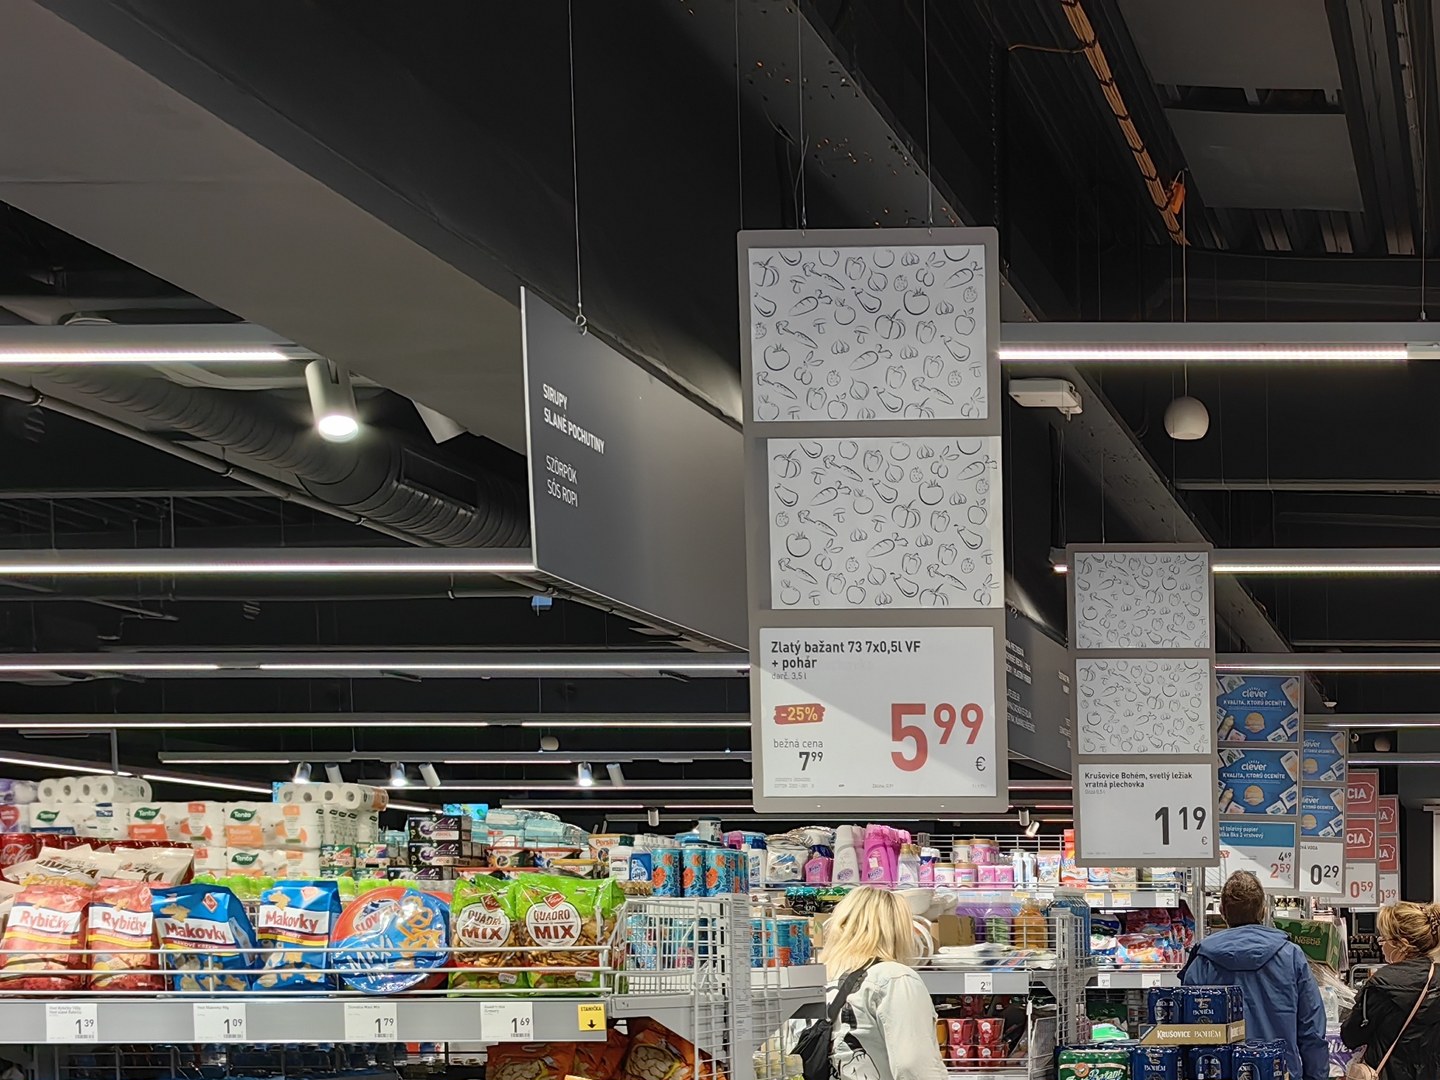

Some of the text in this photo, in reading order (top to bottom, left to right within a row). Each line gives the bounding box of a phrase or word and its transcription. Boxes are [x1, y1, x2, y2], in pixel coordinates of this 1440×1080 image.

[543, 383, 568, 410] SIRUPY
[543, 407, 605, 454] SLANÉ POCHUTINY
[561, 486, 578, 507] ROPI
[771, 640, 800, 656] Zlatý
[804, 640, 845, 653] bažant
[847, 641, 862, 653] 73
[904, 641, 921, 653] VF
[782, 656, 818, 672] pohár
[1241, 688, 1268, 698] clever
[780, 707, 818, 721] -25%
[773, 738, 824, 749] bežná cena
[975, 756, 986, 772] €
[1241, 762, 1268, 771] clever
[1085, 771, 1120, 780] Krušovice
[1149, 771, 1170, 781] svetlý
[1171, 771, 1193, 780] ležiak
[1109, 780, 1145, 790] plechovka
[19, 910, 71, 933] Rybičky
[101, 910, 148, 936] Rybičky
[265, 910, 319, 934] Makovky
[532, 908, 571, 922] QUADRO
[164, 921, 228, 944] Makovky
[461, 928, 502, 941] MIX
[533, 924, 575, 940] MIX
